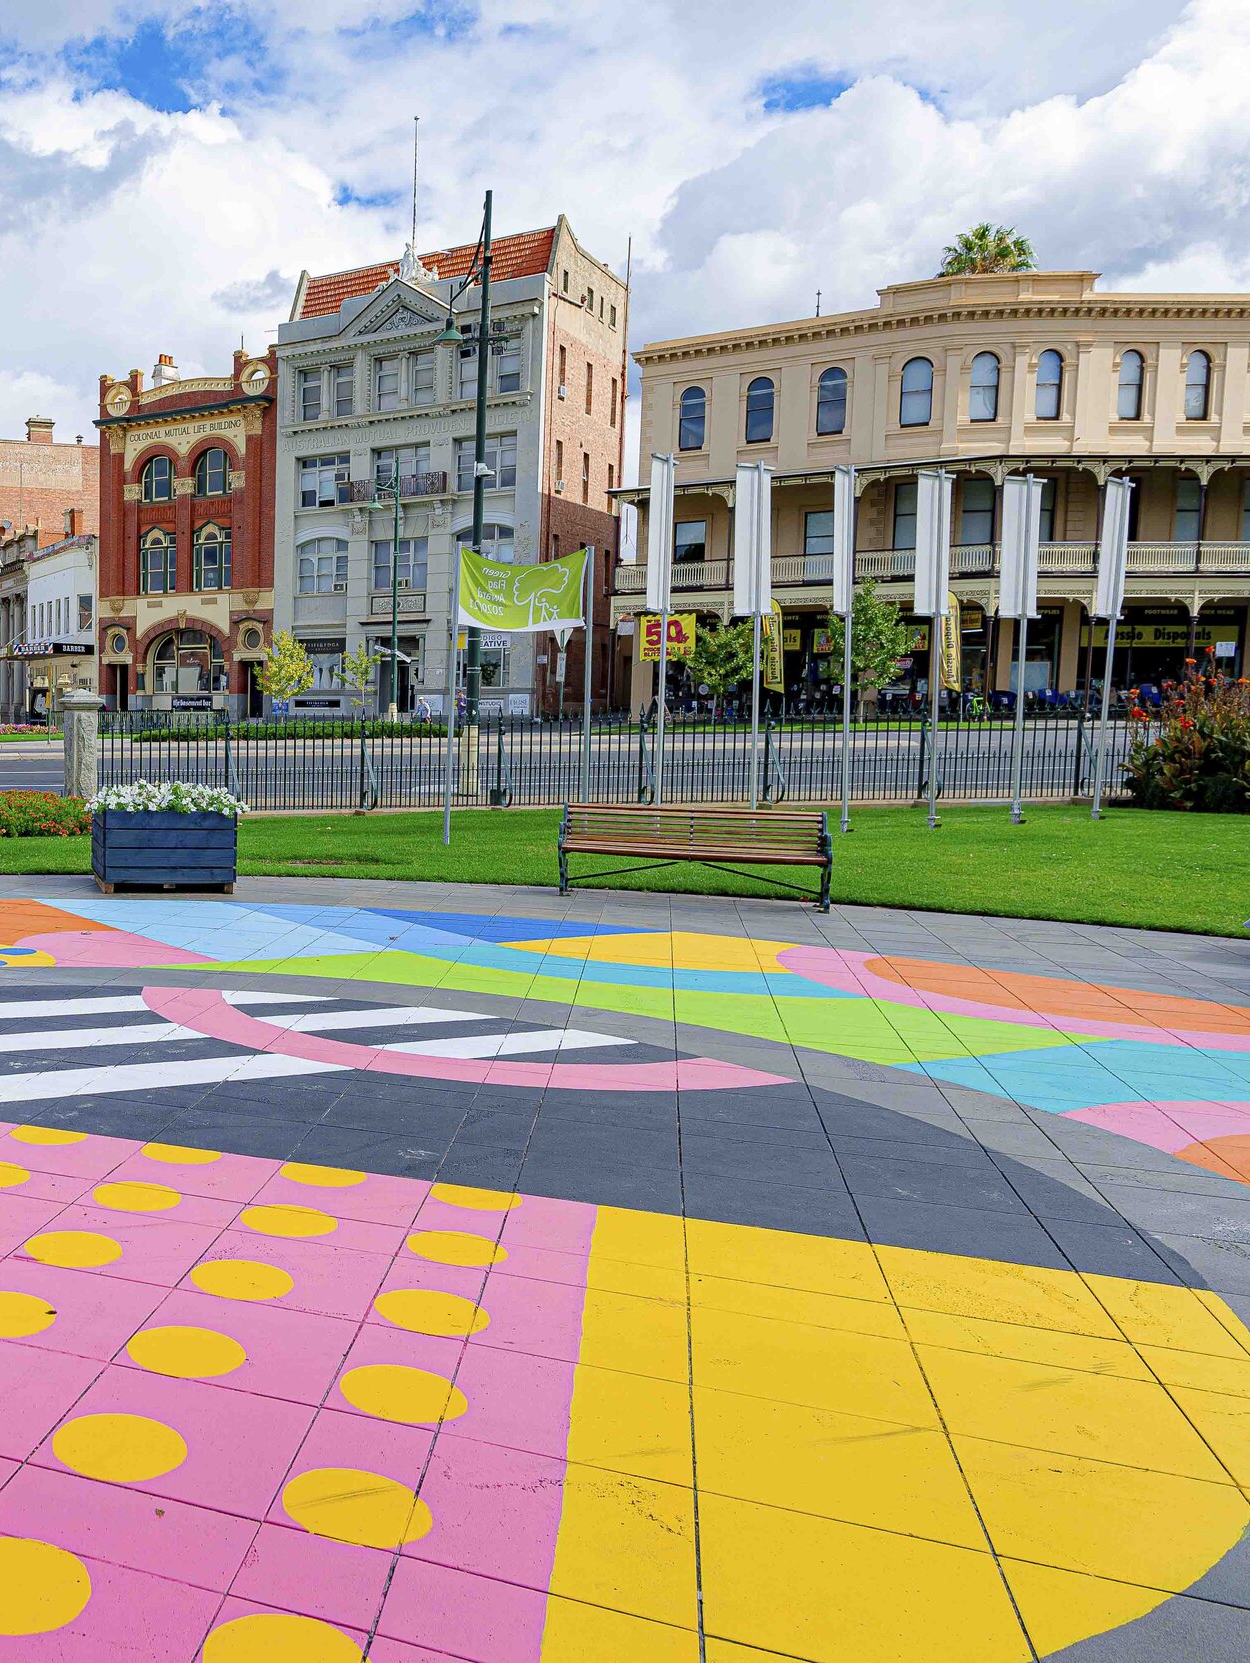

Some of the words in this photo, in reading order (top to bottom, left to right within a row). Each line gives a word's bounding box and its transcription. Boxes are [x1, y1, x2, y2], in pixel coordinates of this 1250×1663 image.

[130, 430, 162, 443] COLONIAL
[164, 426, 191, 438] MUTUAL
[193, 423, 208, 434] LIFE
[209, 419, 242, 432] BUILDING
[282, 435, 350, 453] AUSTRALIAN
[355, 427, 401, 444] MUTUAL
[405, 416, 475, 438] PROVIDENT
[486, 408, 533, 427] OCIETY
[1154, 627, 1212, 643] Dispoals
[21, 644, 46, 653] BARBER
[62, 644, 86, 653] BARBER
